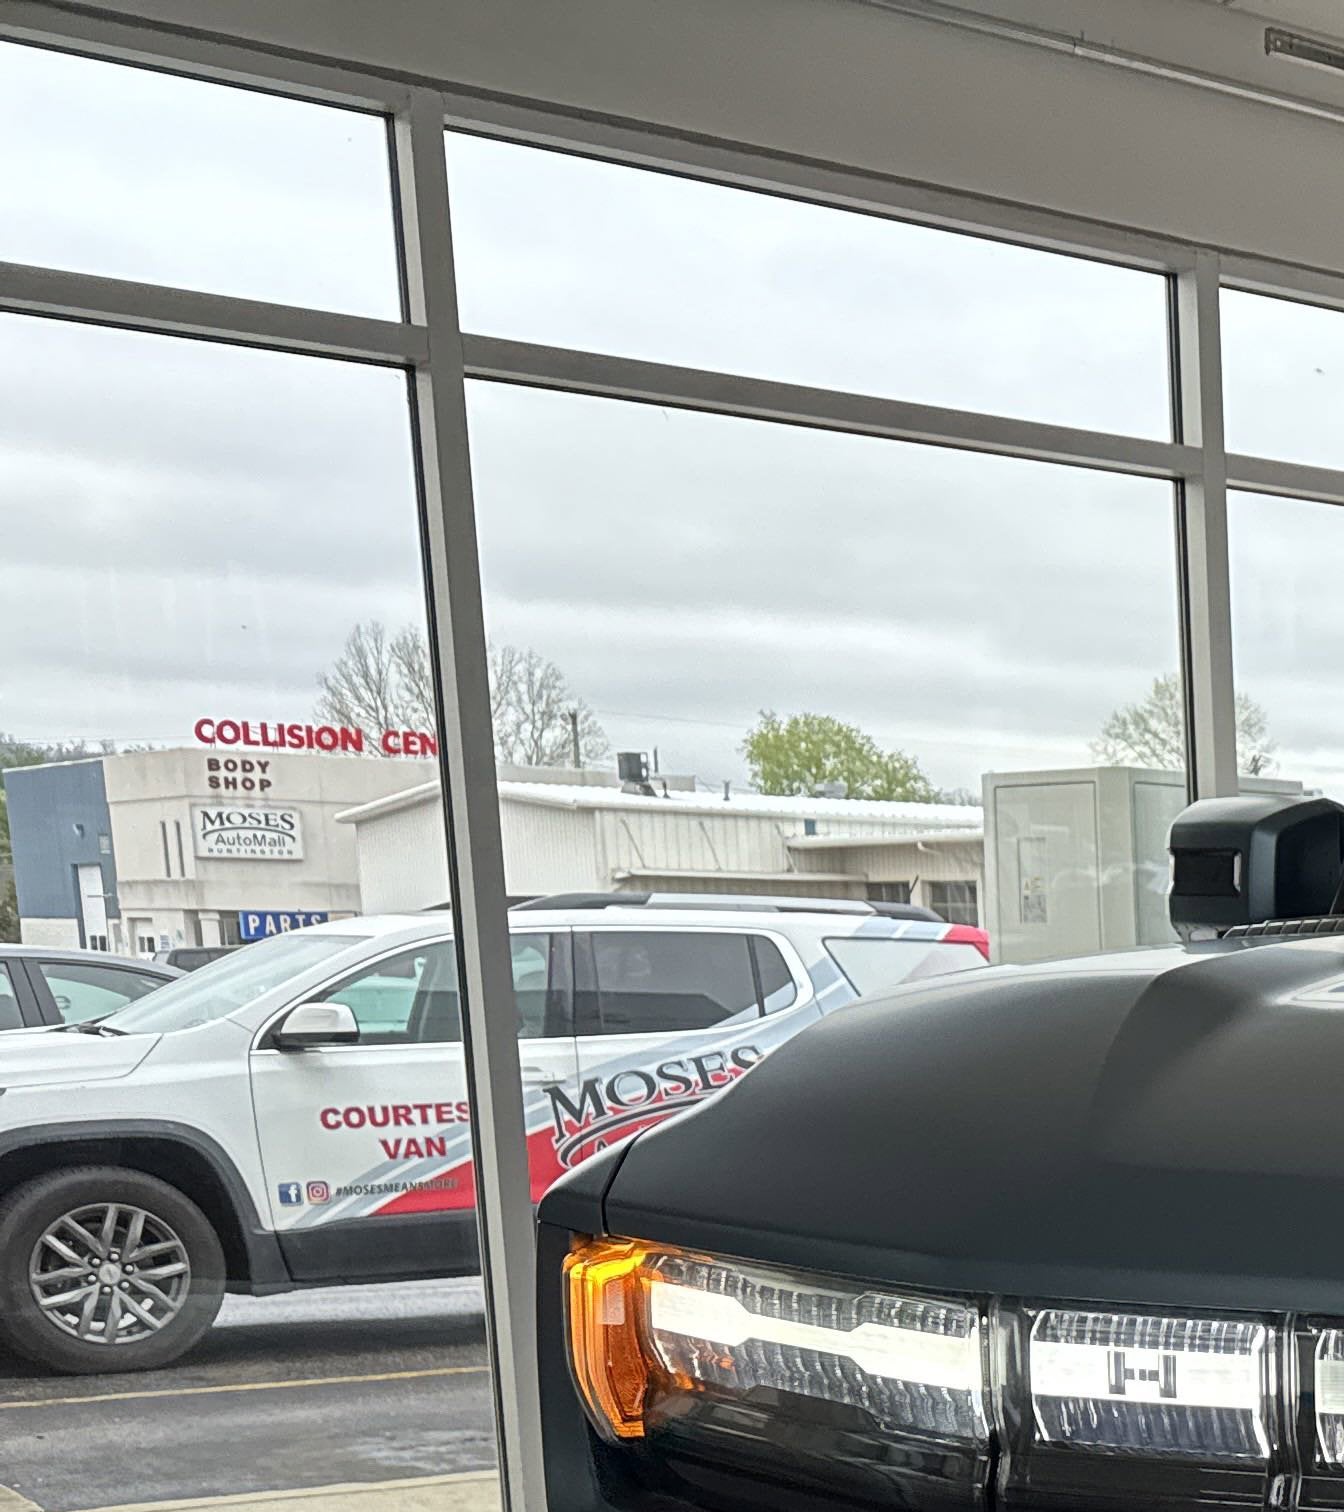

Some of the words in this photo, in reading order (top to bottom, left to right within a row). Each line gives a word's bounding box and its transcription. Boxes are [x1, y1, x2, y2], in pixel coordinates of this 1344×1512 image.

[194, 718, 363, 751] COLLISION
[207, 758, 271, 774] BODY
[207, 776, 272, 792] SHOP
[200, 810, 295, 831] MOSES
[215, 832, 286, 847] AutoMall
[542, 1045, 763, 1145] MOSES
[379, 1137, 447, 1160] VAN
